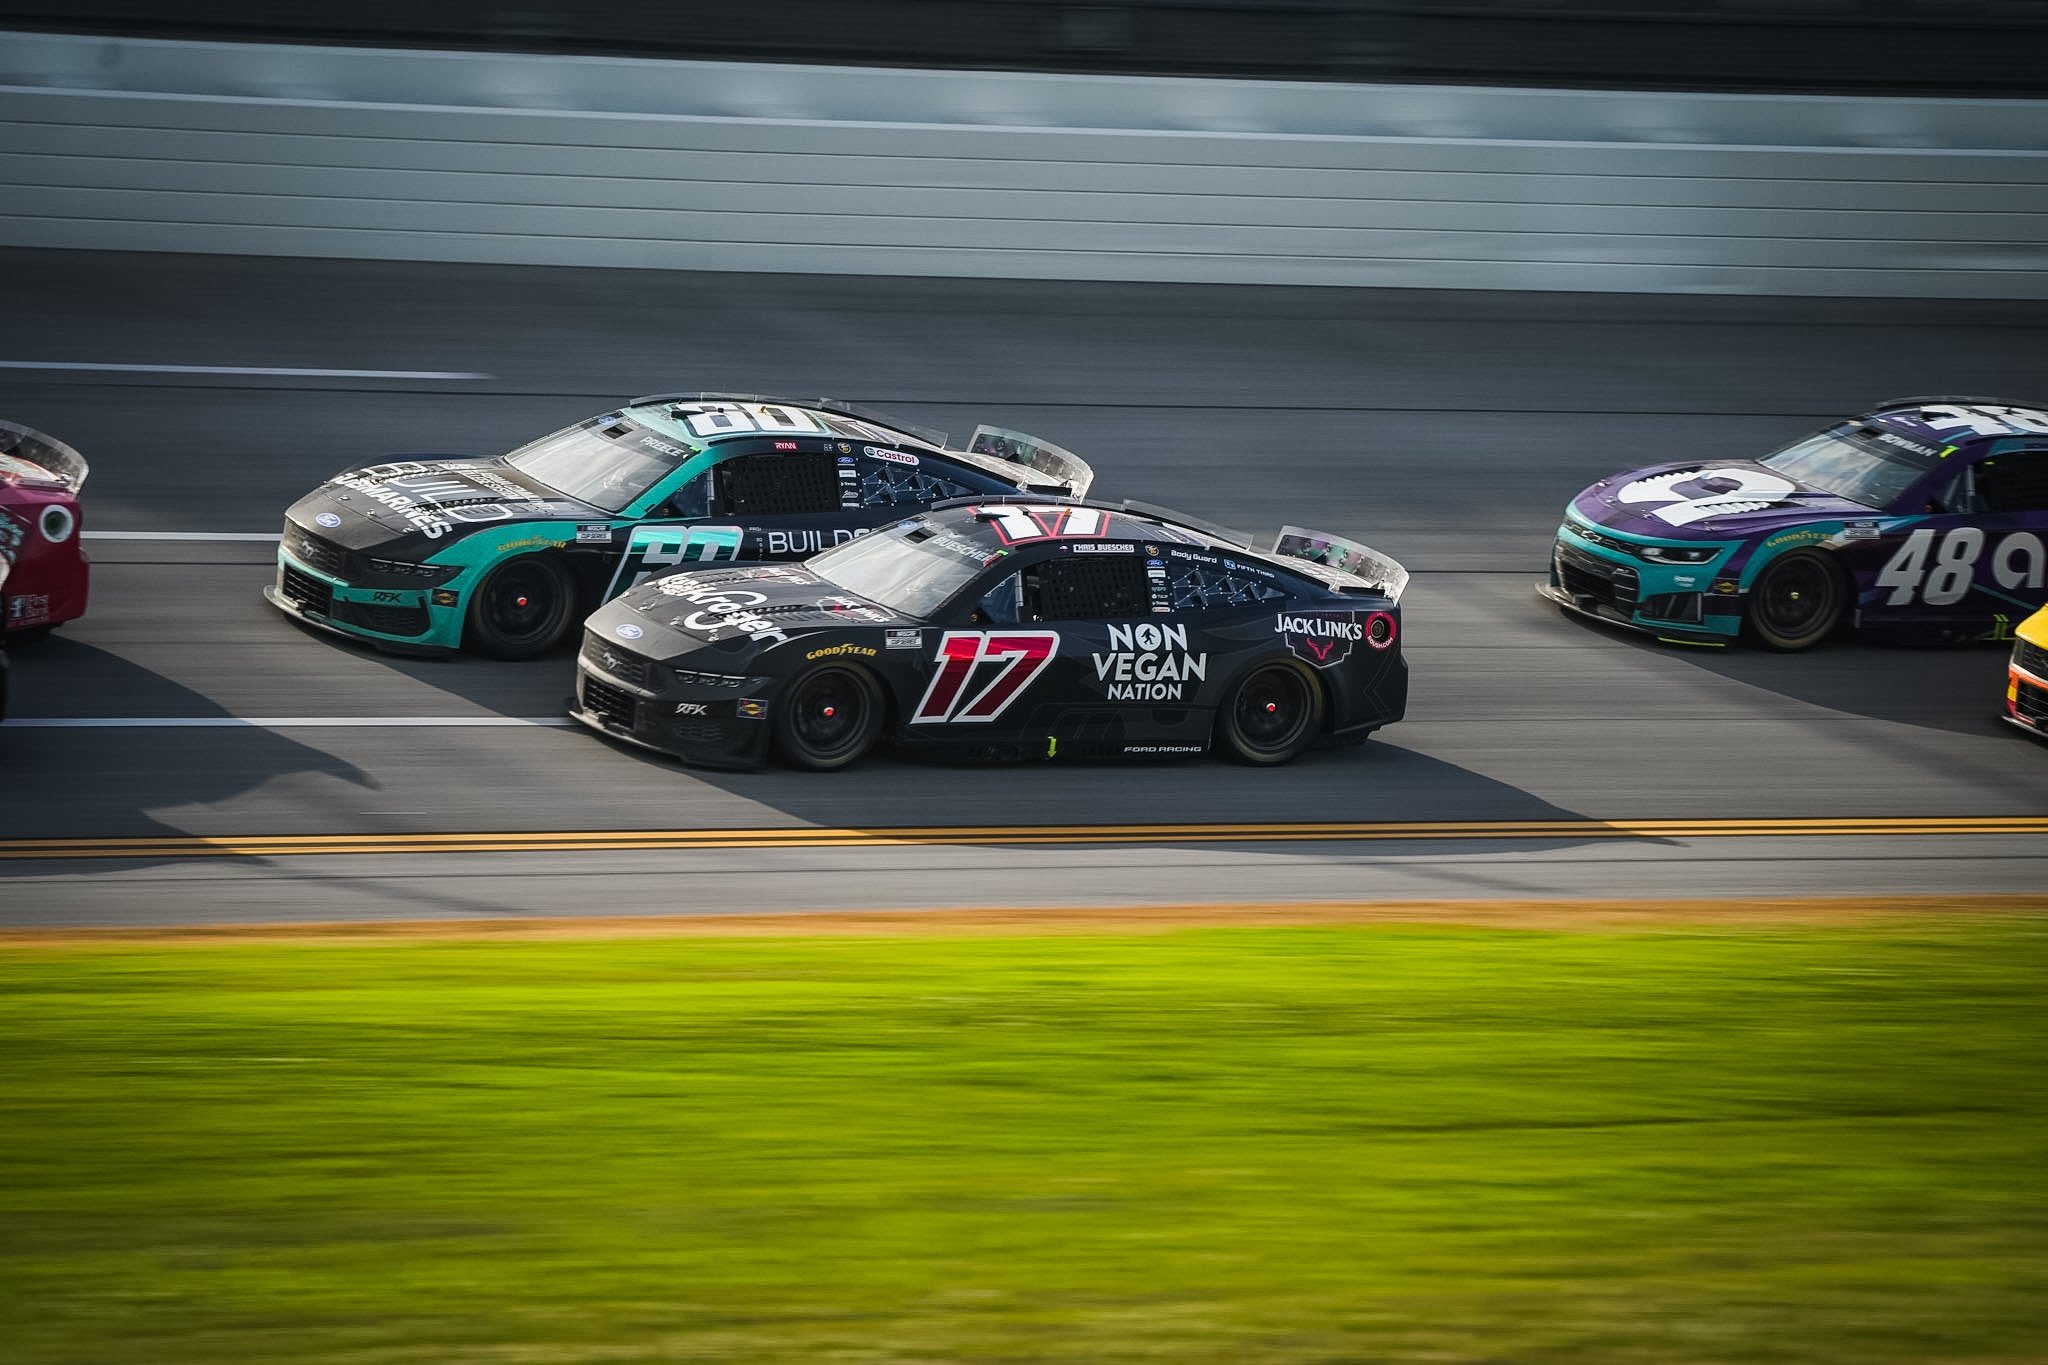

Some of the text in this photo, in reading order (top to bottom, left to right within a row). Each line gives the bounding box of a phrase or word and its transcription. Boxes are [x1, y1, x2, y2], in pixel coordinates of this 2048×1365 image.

[640, 436, 685, 458] PREECE
[774, 442, 797, 450] RYAN
[1878, 433, 1938, 456] BOWMAN
[876, 449, 915, 464] Castrol
[931, 535, 994, 562] BUESCHER
[1097, 543, 1135, 552] BUESCHER
[1171, 549, 1192, 560] Body
[1193, 553, 1217, 563] Guard
[1237, 563, 1275, 578] FIFTH THIRD
[1875, 527, 1984, 606] 48
[1106, 623, 1188, 651] NON
[1275, 613, 1363, 641] JACK LINK'S
[806, 643, 877, 660] GOODYEAR
[910, 630, 1060, 724] 17
[1092, 652, 1207, 681] VEGAN
[1107, 683, 1182, 700] NATION
